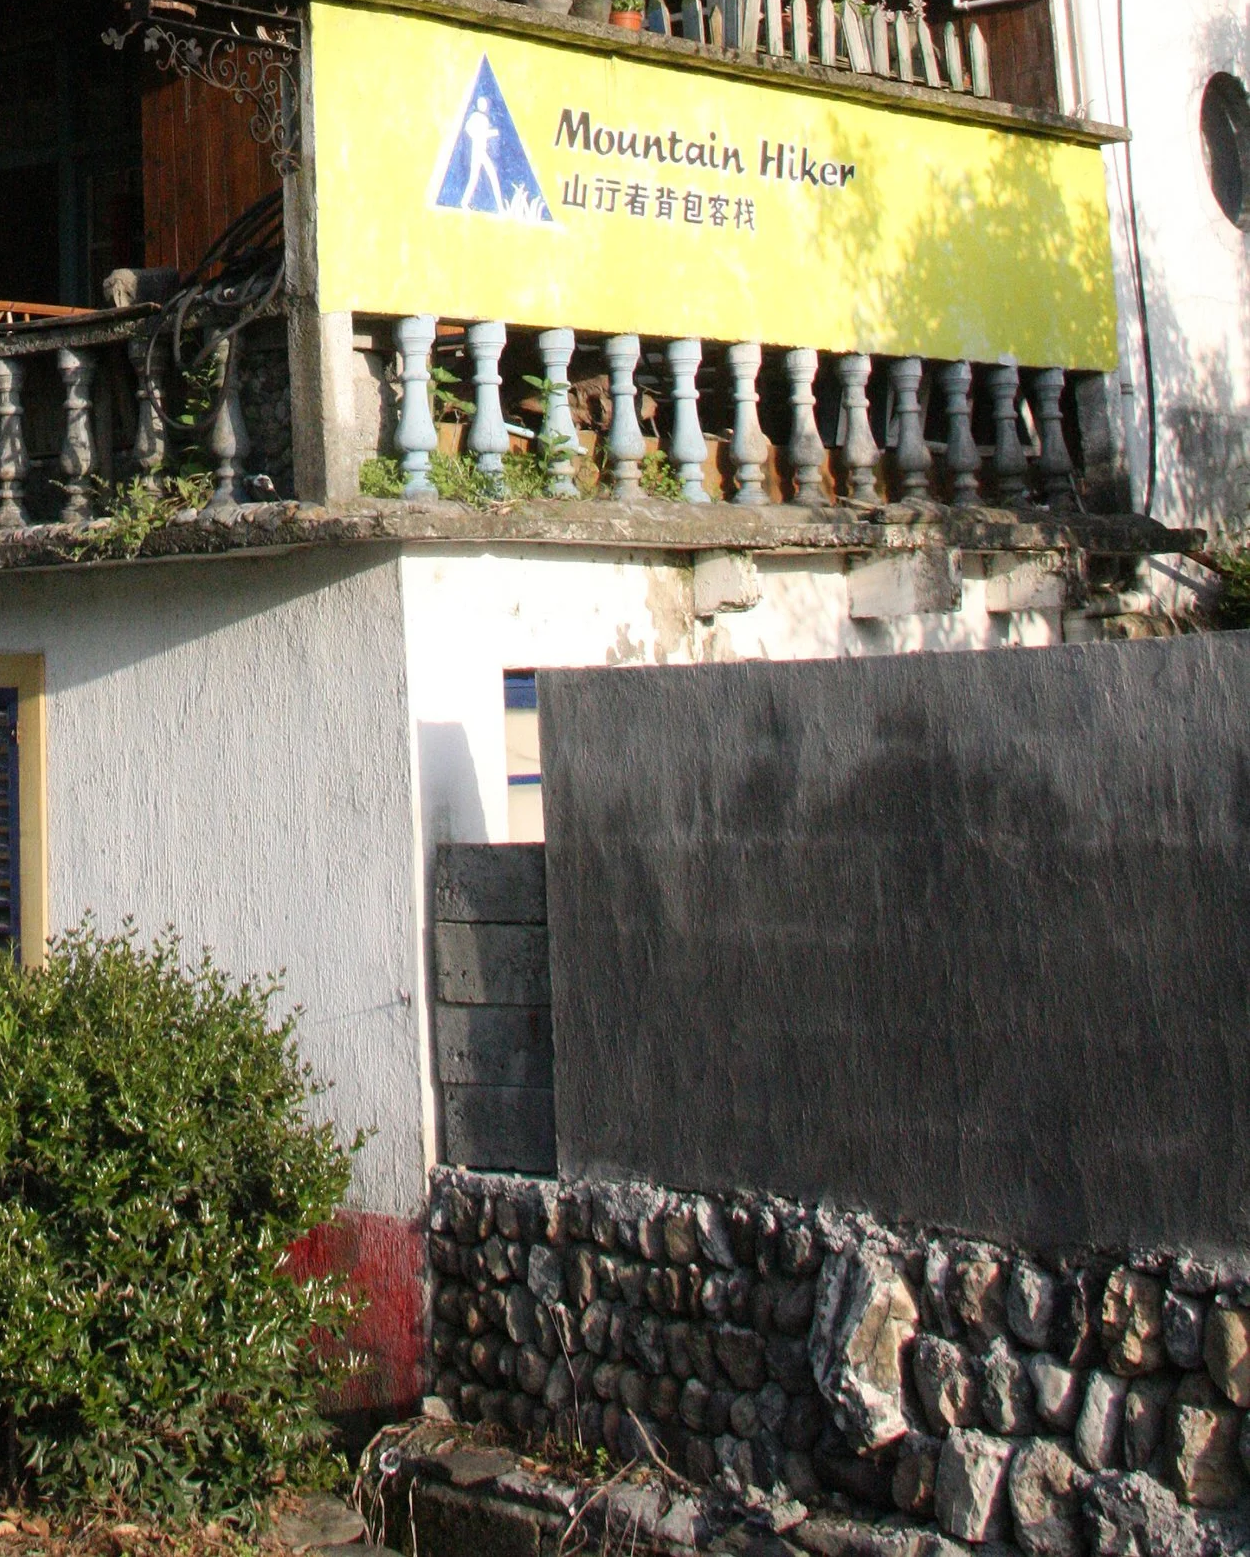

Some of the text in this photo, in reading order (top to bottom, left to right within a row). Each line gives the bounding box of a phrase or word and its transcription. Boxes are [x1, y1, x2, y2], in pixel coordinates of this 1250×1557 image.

[555, 109, 855, 187] Mountain Hiker
[561, 174, 755, 231] 山行者背包客栈
